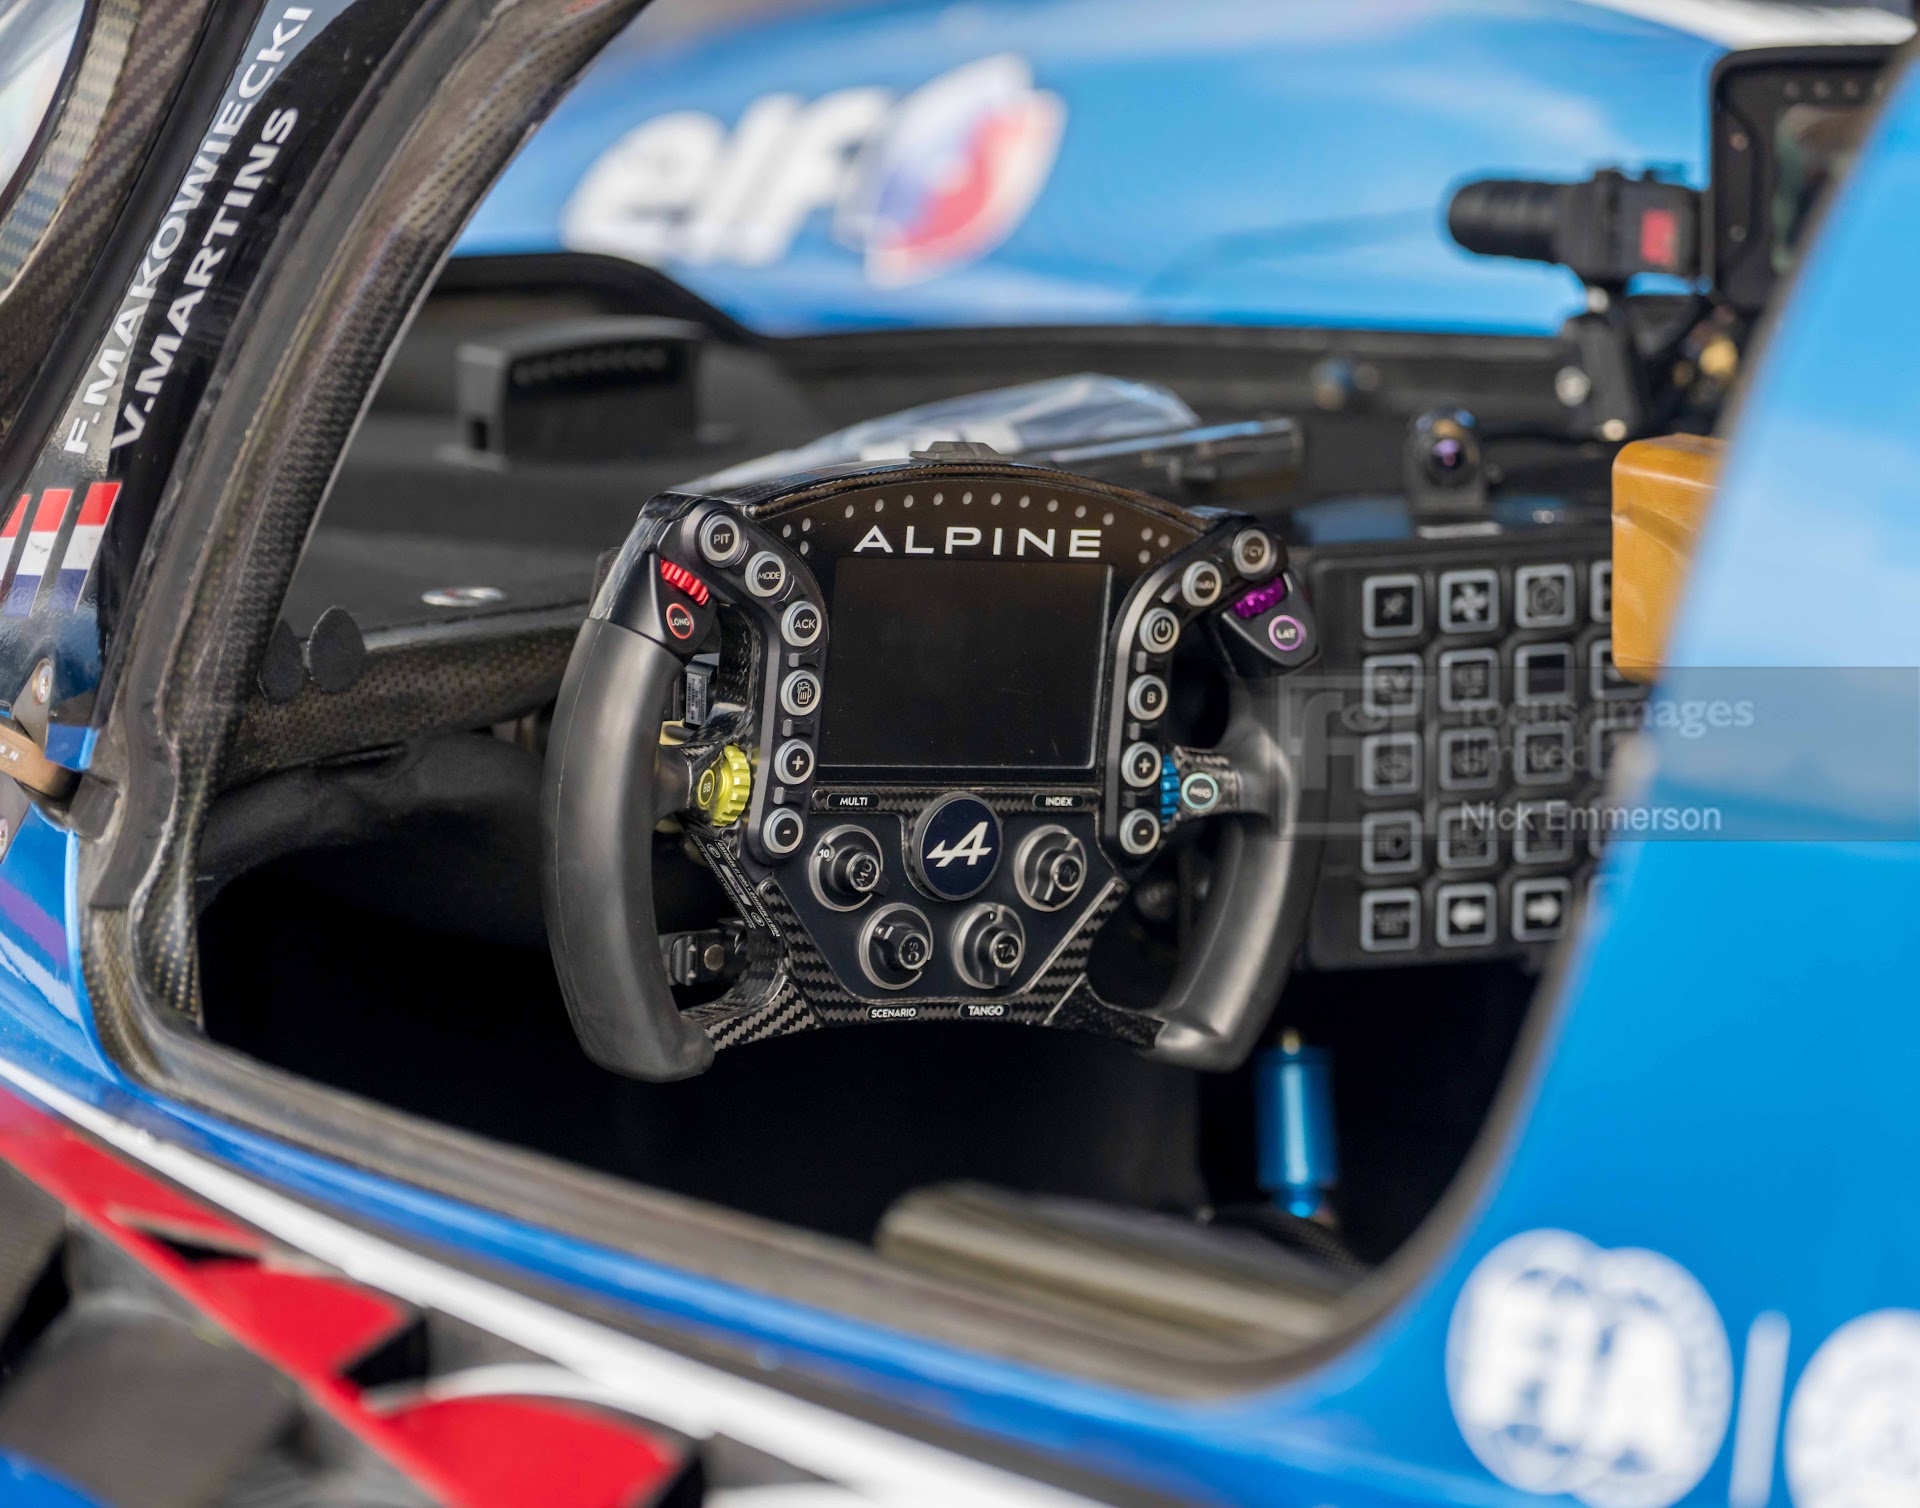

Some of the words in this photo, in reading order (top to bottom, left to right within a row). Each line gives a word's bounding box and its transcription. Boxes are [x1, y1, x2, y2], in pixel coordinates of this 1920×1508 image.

[561, 84, 902, 268] elf
[63, 6, 314, 455] F.MAKOWIECKI
[111, 106, 299, 450] V.MARTINS
[713, 533, 731, 545] PIT
[853, 524, 1102, 558] ALPINE
[757, 571, 781, 581] MODE
[670, 618, 690, 626] LONG
[794, 618, 816, 629] ACK
[1275, 628, 1297, 639] LAT
[1146, 690, 1157, 704] B
[839, 797, 868, 806] MULTI
[1045, 796, 1074, 807] INDEX
[820, 849, 829, 858] 10
[997, 944, 1016, 958] TA
[871, 1008, 917, 1018] SCENARIO
[967, 1005, 1004, 1017] TANGO
